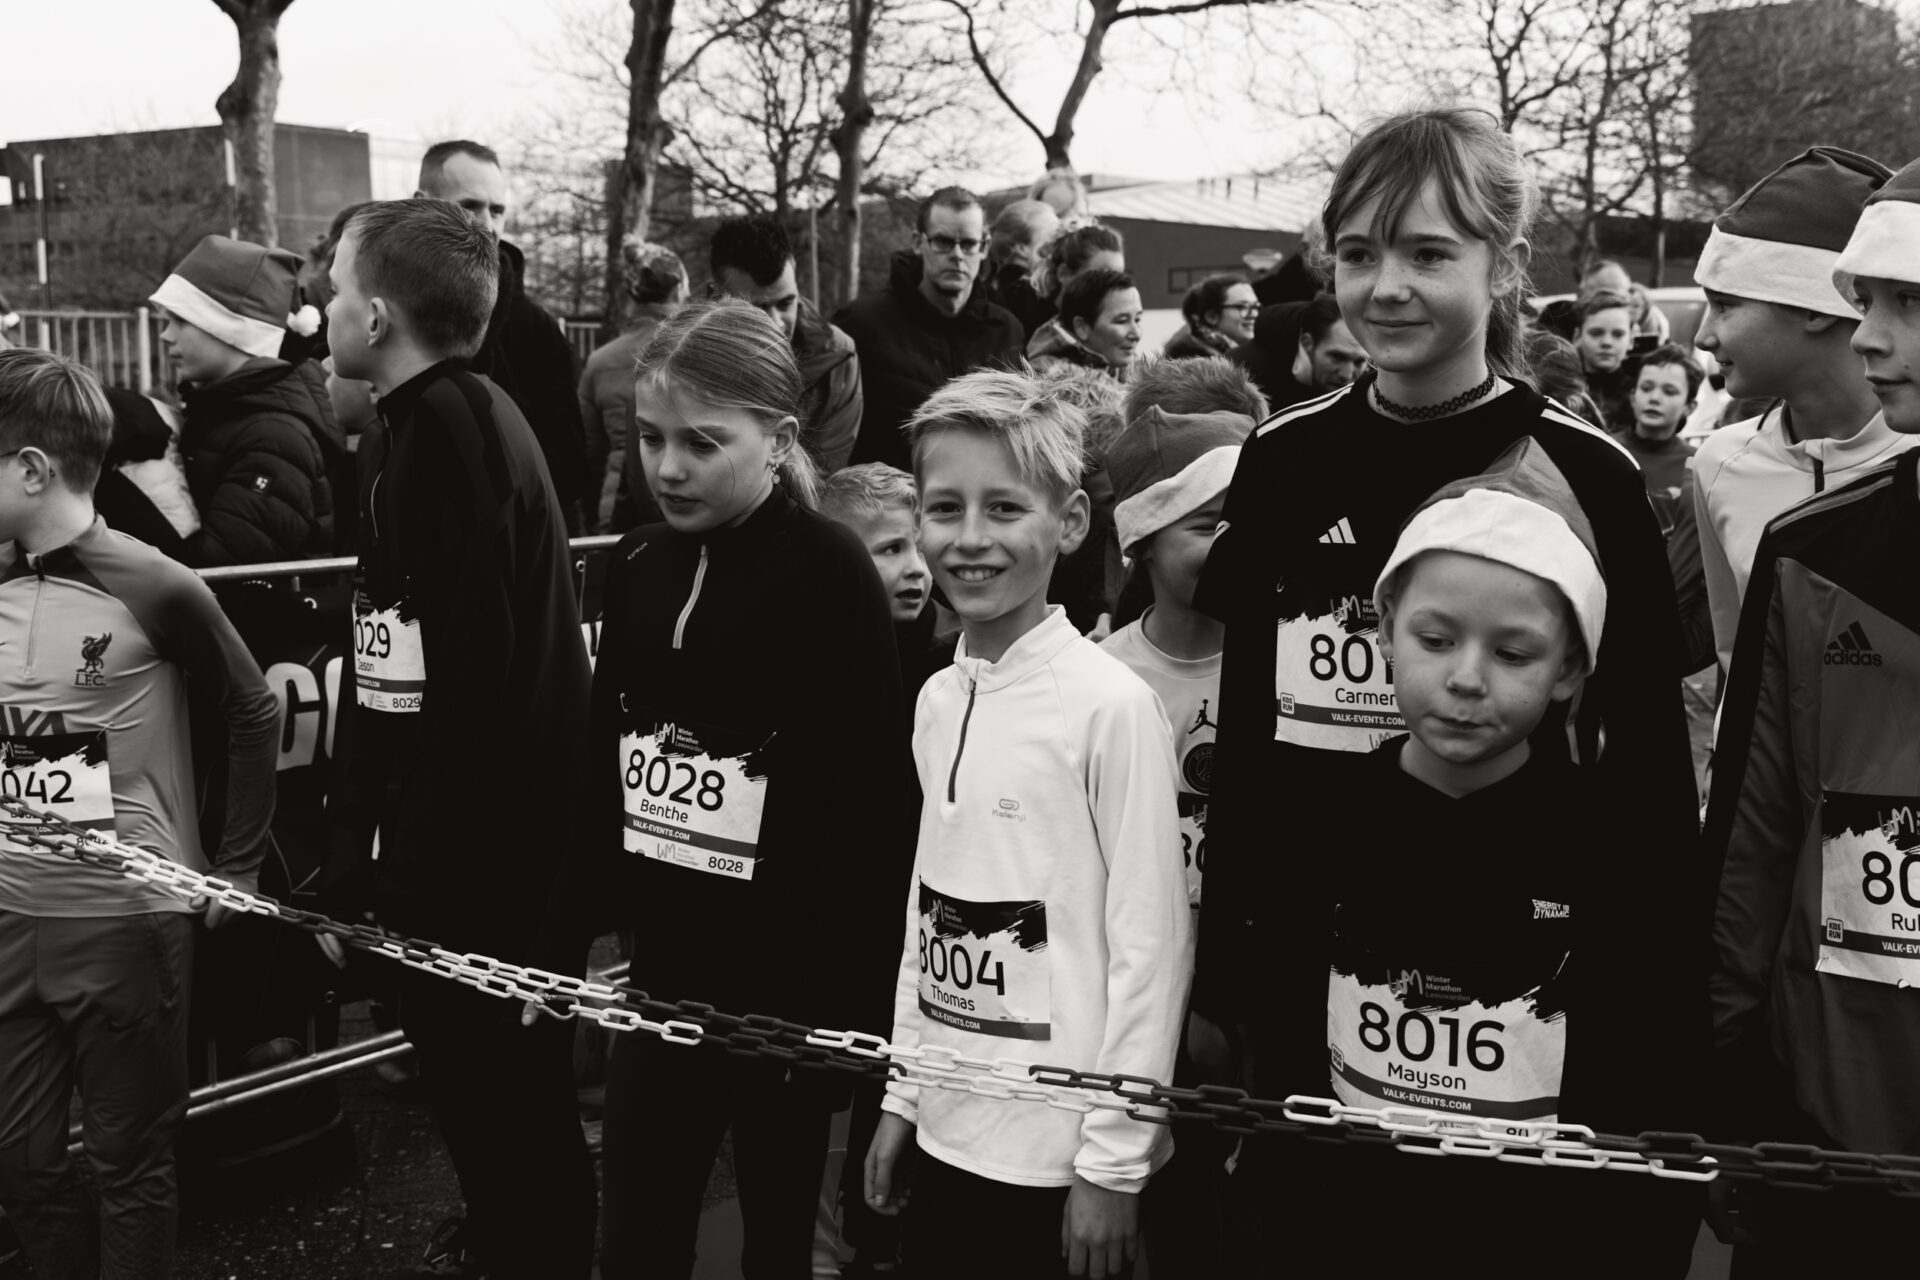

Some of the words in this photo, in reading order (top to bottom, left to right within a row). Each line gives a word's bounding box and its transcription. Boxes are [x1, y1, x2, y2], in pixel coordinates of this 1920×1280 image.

[355, 620, 391, 659] 029
[1824, 649, 1883, 666] adidas
[392, 698, 421, 708] 8029
[1331, 713, 1406, 726] VALK-EVENTS.COM
[2, 770, 75, 804] 042
[626, 749, 725, 811] 8028
[640, 799, 689, 823] Benthe
[633, 819, 690, 841] VALK-EVENTS.COM
[708, 856, 743, 873] 8028
[1862, 851, 1920, 908] 80
[1533, 908, 1570, 919] DYNAMIC
[1828, 930, 1841, 940] RUN
[1829, 922, 1841, 931] KIDS
[919, 928, 1005, 996] 8004
[1425, 983, 1462, 993] Marathon
[1426, 975, 1451, 984] Winter
[931, 984, 975, 1011] Thomas
[930, 1007, 981, 1030] VALK-EVENTS.COM
[1358, 1002, 1505, 1072] 8016
[1388, 1062, 1466, 1090] Mayson
[1382, 1087, 1471, 1111] VALK-EVENTS.COM
